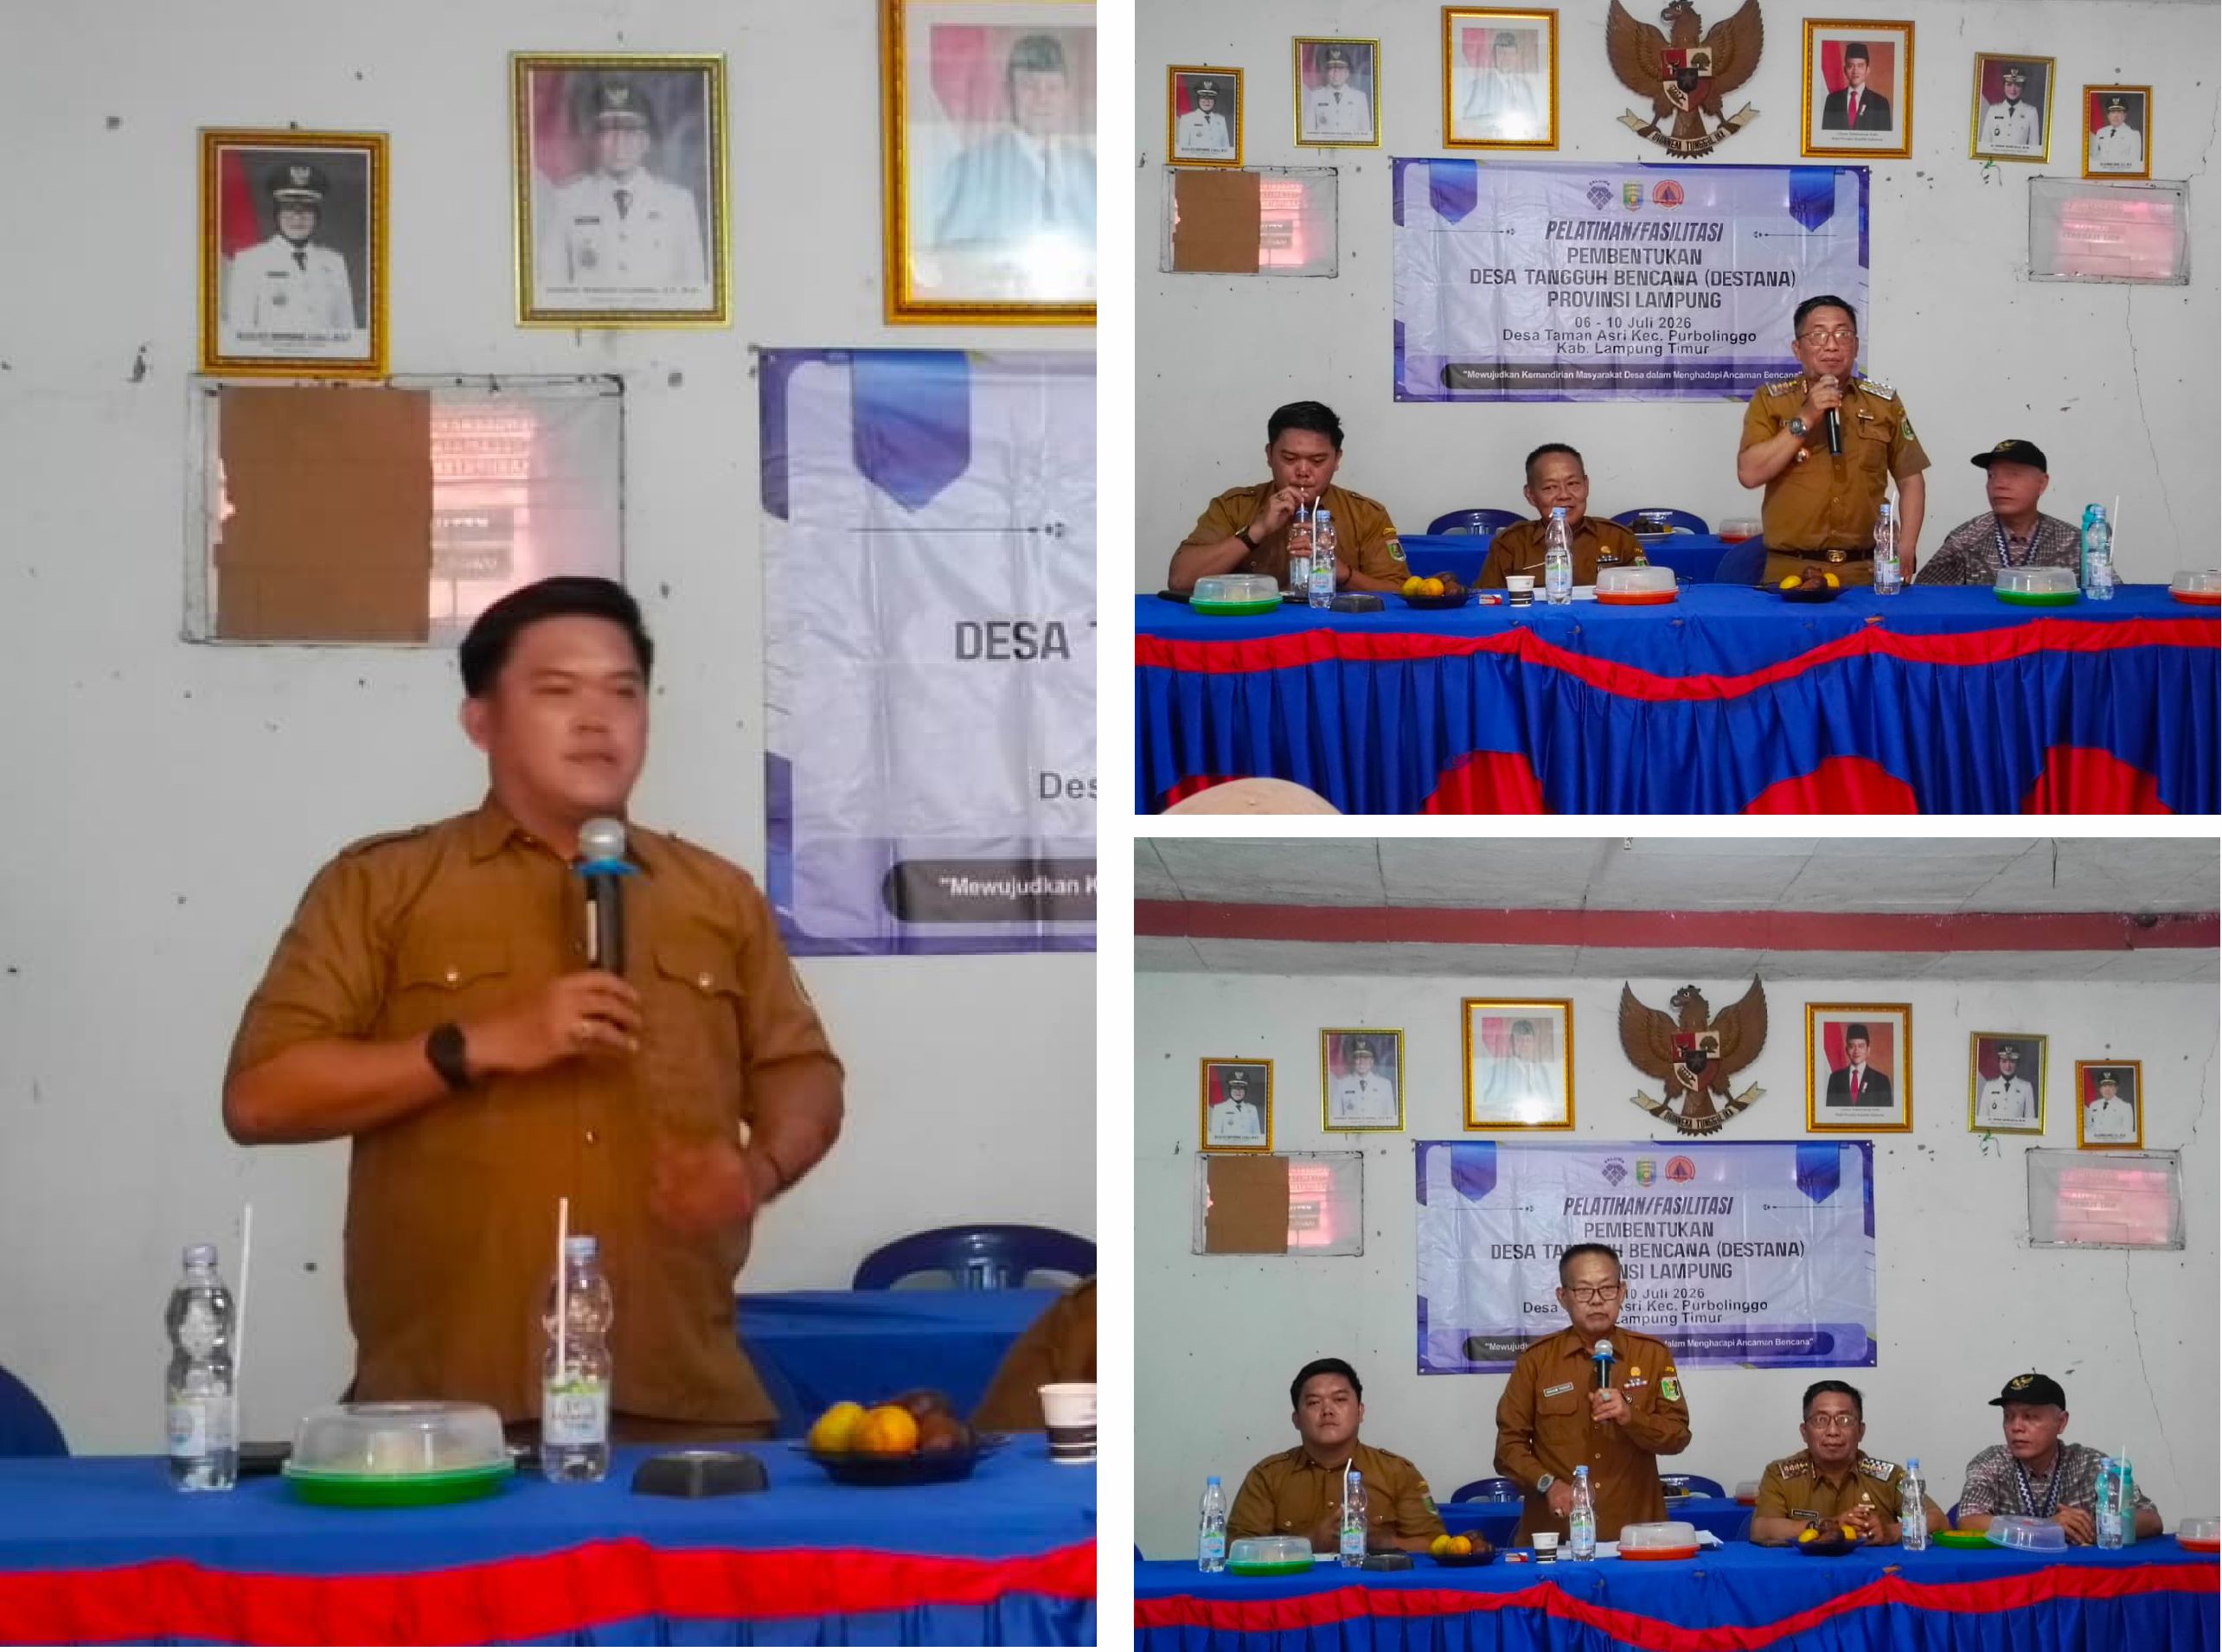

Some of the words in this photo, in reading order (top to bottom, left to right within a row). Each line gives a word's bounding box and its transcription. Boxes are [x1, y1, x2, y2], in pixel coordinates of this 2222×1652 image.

[1545, 221, 1724, 242] PELATIHAN/FASILITASI
[1567, 247, 1702, 265] PEMBENTUKAN
[1470, 268, 1517, 285] DESA
[1525, 269, 1608, 285] TANGGUH
[1614, 270, 1698, 286] BENCANA
[1705, 269, 1796, 288] (DESTANA)
[1547, 291, 1630, 308] PROVINSI
[1636, 291, 1721, 308] LAMPUNG
[1575, 317, 1591, 328] 06
[1606, 317, 1623, 328] 10
[1628, 317, 1654, 329] Juli
[1658, 317, 1692, 329] 2026
[1503, 329, 1540, 341] Desa
[1544, 329, 1592, 341] Taman
[1597, 330, 1627, 341] Asri
[1631, 330, 1663, 342] Kec.
[1668, 330, 1757, 344] Purbolinggo
[1557, 343, 1589, 354] Kab.
[1595, 343, 1662, 356] Lampung
[1668, 343, 1710, 355] Timur
[1576, 370, 1623, 381] Masyarakat
[1624, 370, 1644, 379] Desa
[1646, 370, 1671, 379] dalam
[1673, 370, 1723, 381] Menghadapi
[1723, 370, 1762, 379] Ancaman
[955, 621, 1071, 660] DESA
[1563, 1196, 1733, 1216] PELATIHAN/FASILITASI
[1585, 1221, 1714, 1238] PEMBENTUKAN
[1491, 1244, 1536, 1259] DESA
[1630, 1242, 1711, 1258] BENCANA
[1717, 1240, 1805, 1259] (DESTANA)
[1650, 1263, 1732, 1279] LAMPUNG
[1642, 1288, 1668, 1299] Juli
[1674, 1288, 1705, 1298] 2026
[1523, 1302, 1558, 1314] Desa
[1647, 1300, 1677, 1311] Kec.
[1682, 1300, 1768, 1313] Purbolinggo
[1681, 1312, 1722, 1323] Timur
[1485, 1341, 1527, 1352] "Mewujud
[1736, 1338, 1773, 1347] Ancaman
